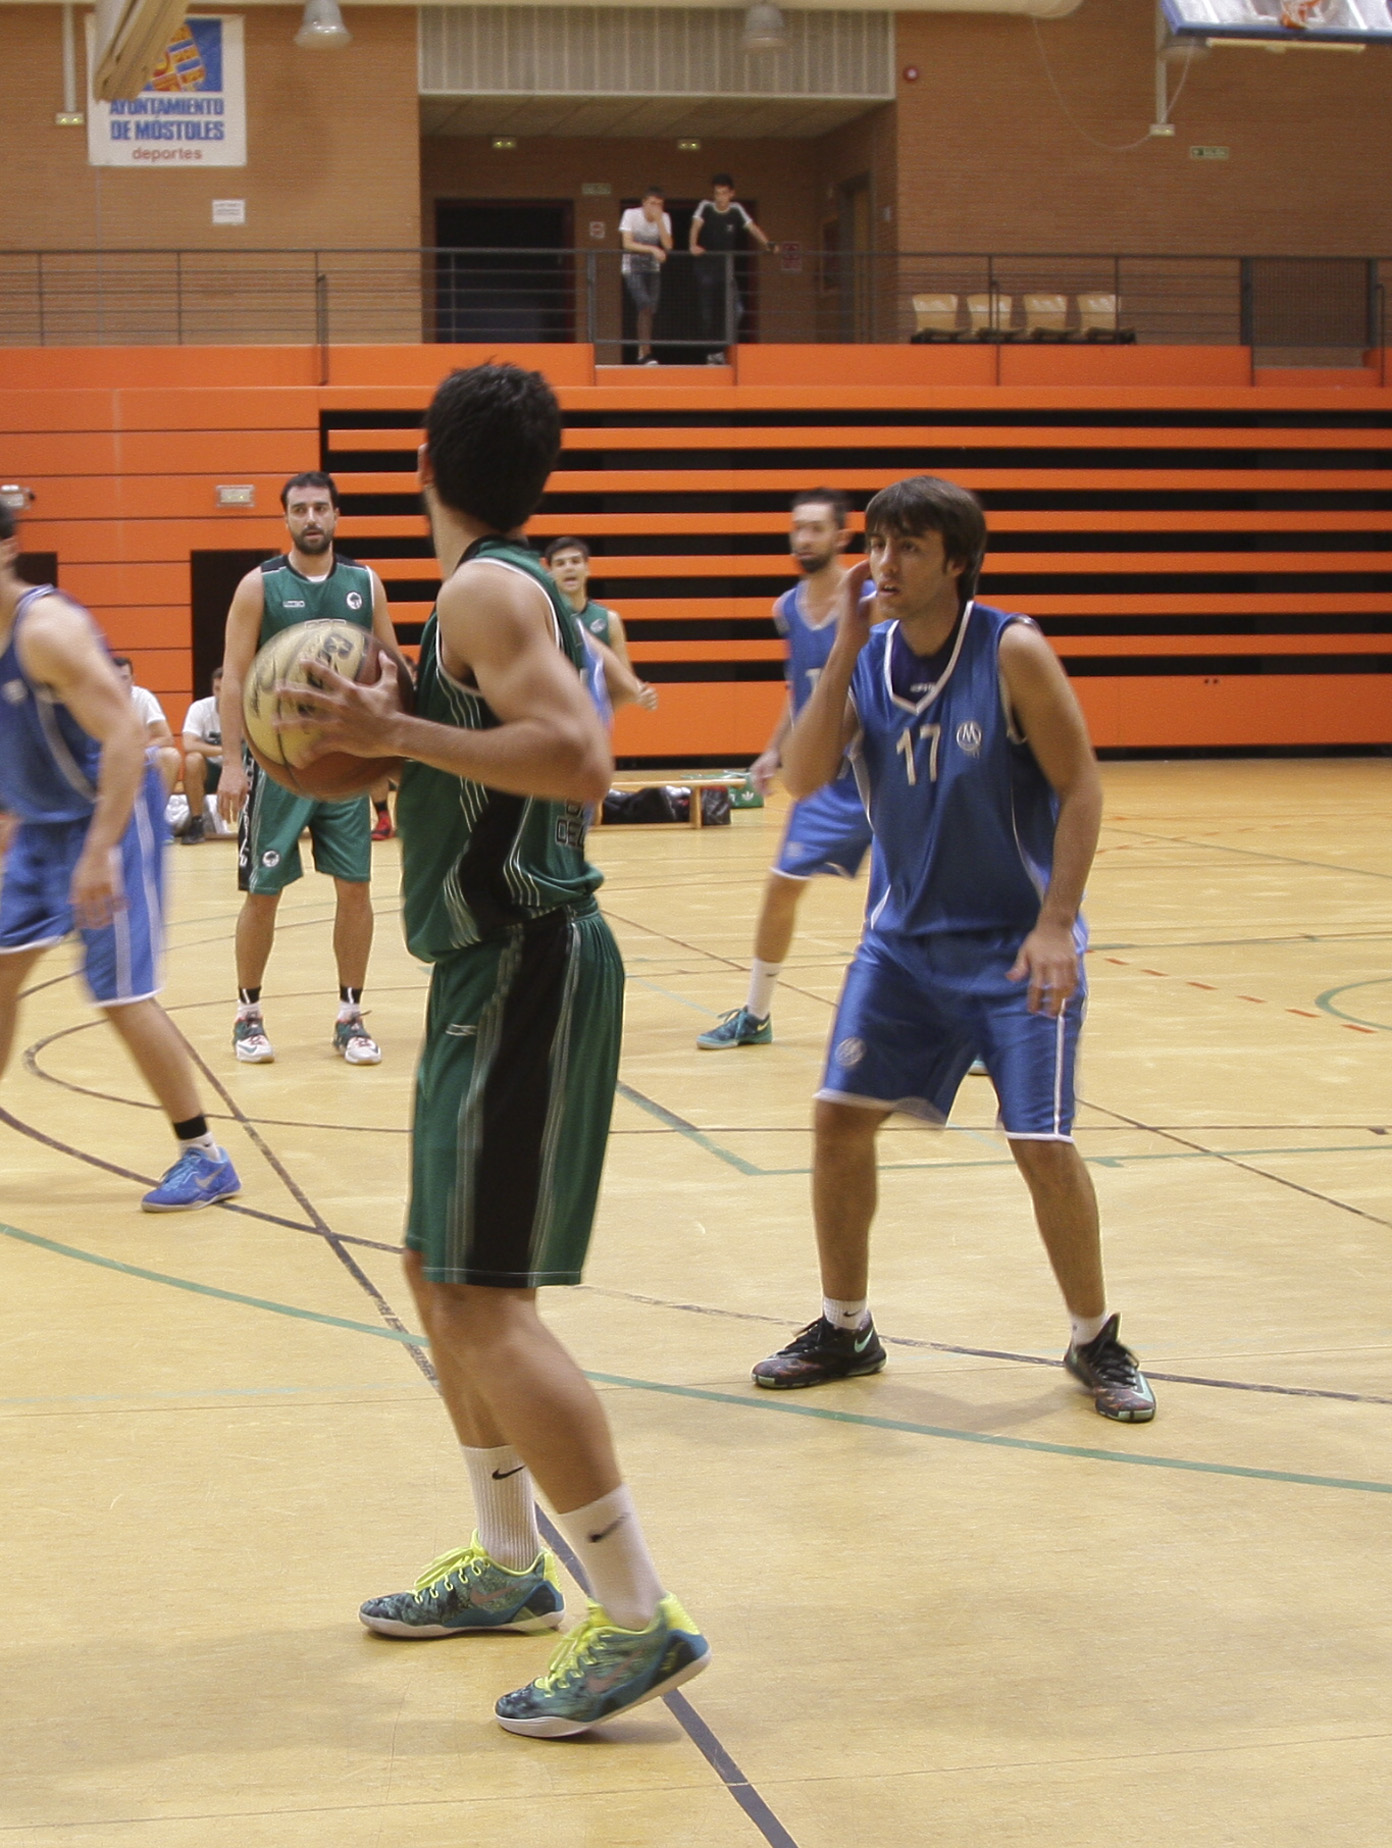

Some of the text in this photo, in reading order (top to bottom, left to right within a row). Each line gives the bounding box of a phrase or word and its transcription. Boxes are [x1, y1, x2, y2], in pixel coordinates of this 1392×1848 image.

[110, 97, 224, 115] AYUNTAMIENTO
[111, 114, 225, 140] DE MÓSTOLES
[132, 148, 202, 162] deportes
[896, 722, 942, 785] 17
